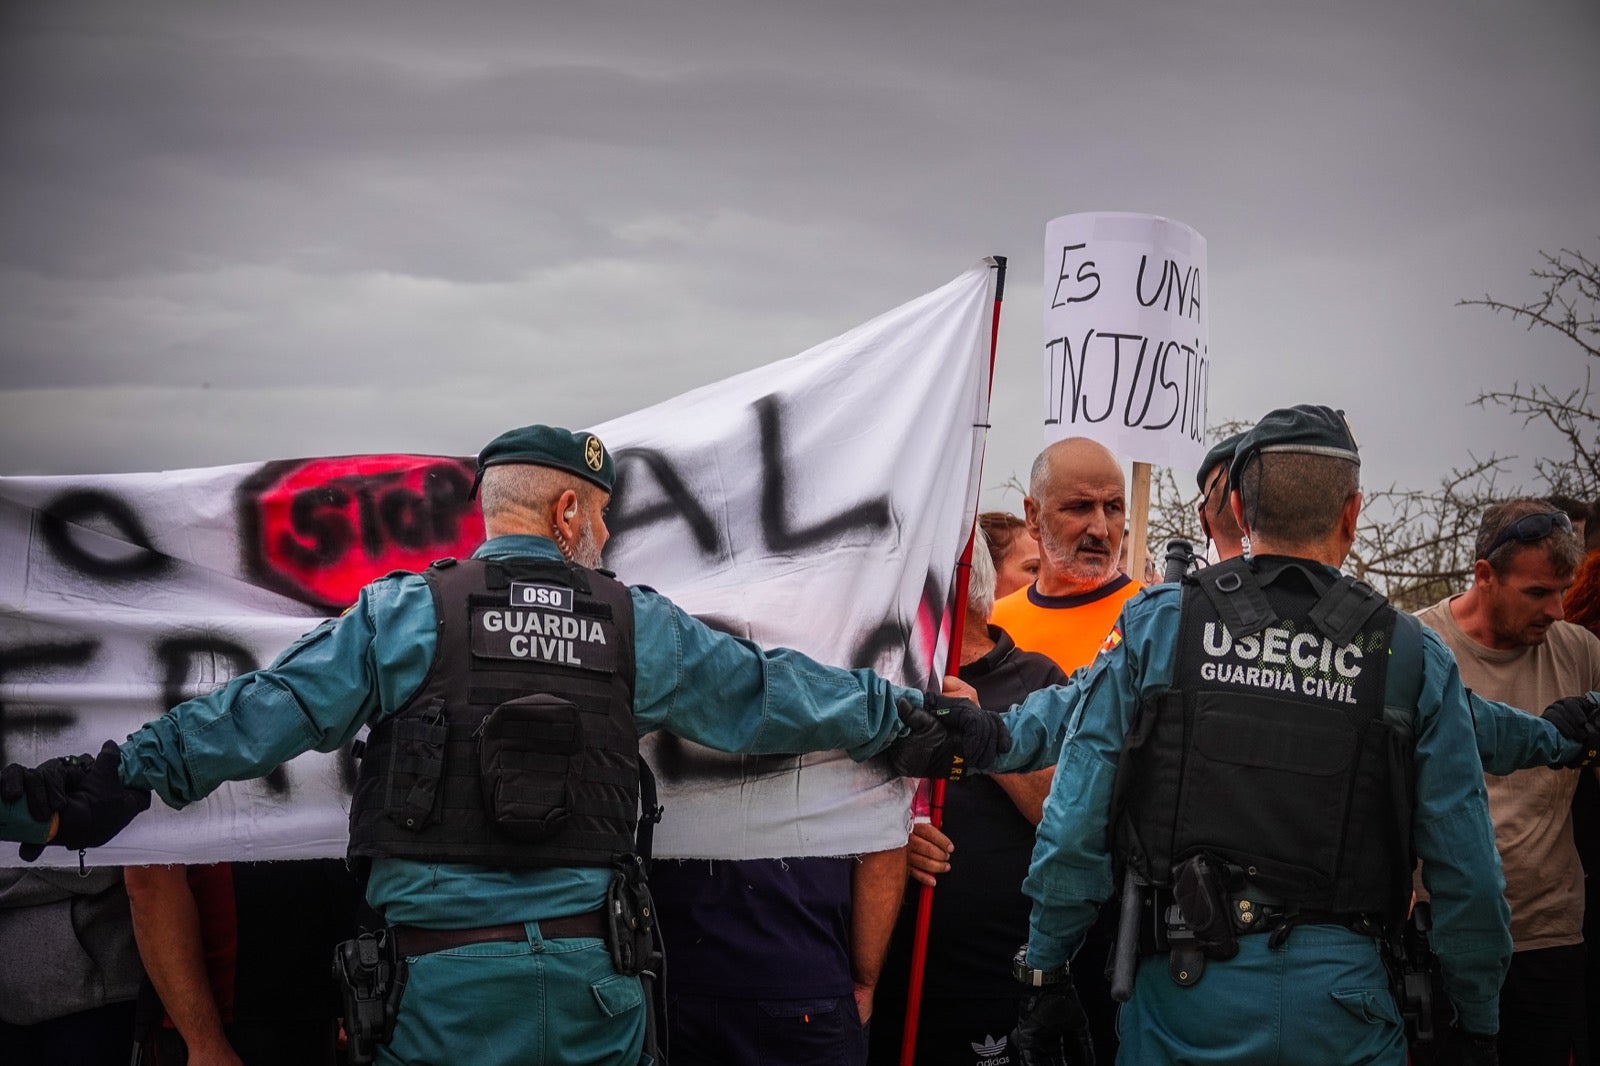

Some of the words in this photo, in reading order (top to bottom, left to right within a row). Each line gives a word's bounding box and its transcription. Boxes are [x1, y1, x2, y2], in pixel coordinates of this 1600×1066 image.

[1135, 255, 1201, 324] UNA
[278, 464, 474, 569] STOP
[523, 587, 562, 607] OSO
[483, 611, 607, 645] GUARDIA
[510, 635, 581, 665] CIVIL
[1202, 621, 1364, 678] USECIC
[1200, 662, 1296, 693] GUARDIA
[1302, 676, 1357, 704] CIVIL
[976, 1056, 1010, 1066] adidas
